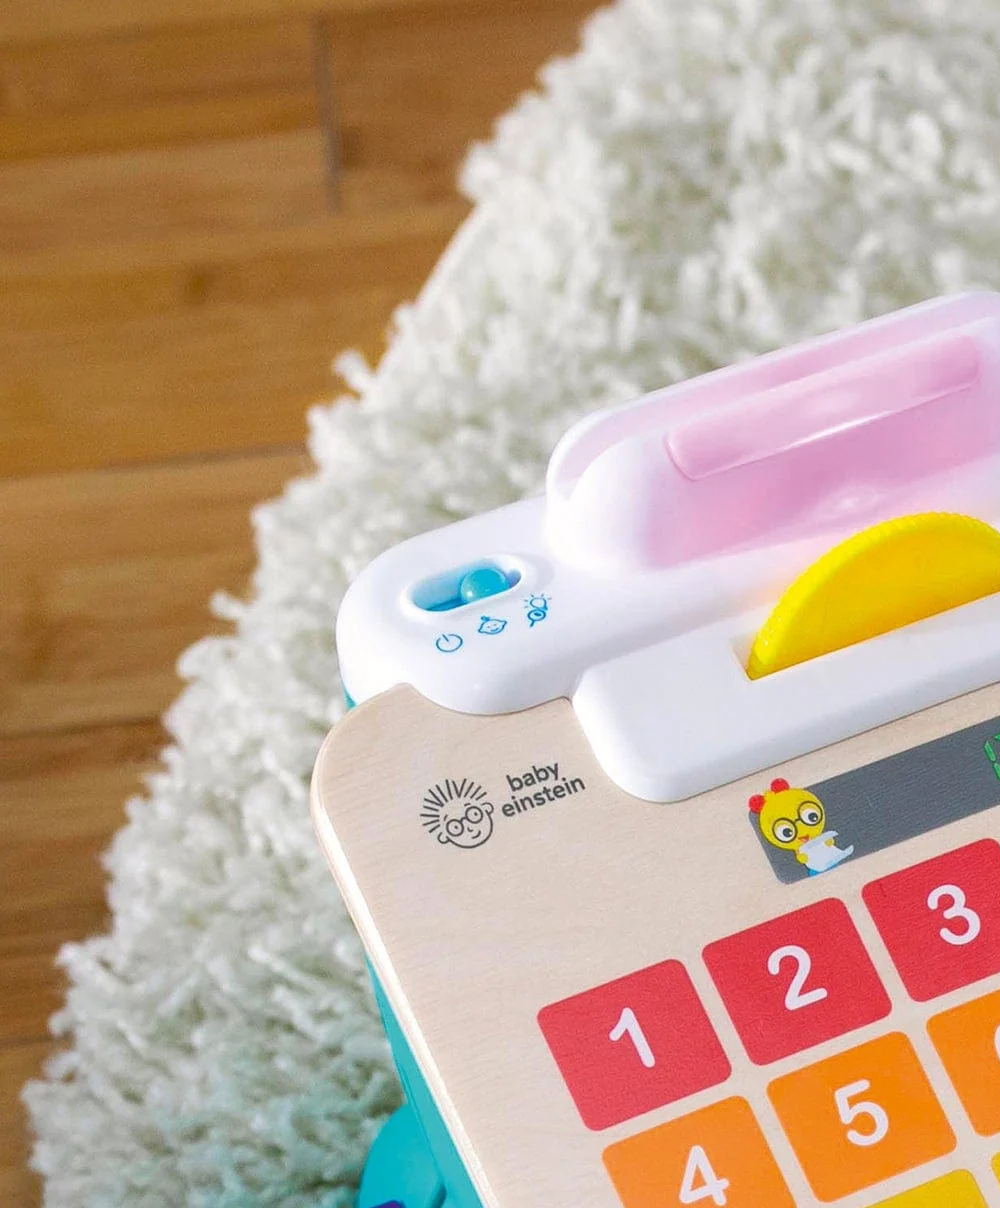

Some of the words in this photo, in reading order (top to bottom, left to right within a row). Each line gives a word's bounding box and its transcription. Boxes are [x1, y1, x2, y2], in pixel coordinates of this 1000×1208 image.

[502, 777, 586, 817] einstein
[506, 762, 559, 792] baby
[927, 884, 981, 945] 3
[767, 945, 828, 1011] 2
[609, 1007, 655, 1068] 1
[834, 1079, 889, 1146] 5
[679, 1145, 730, 1206] 4
